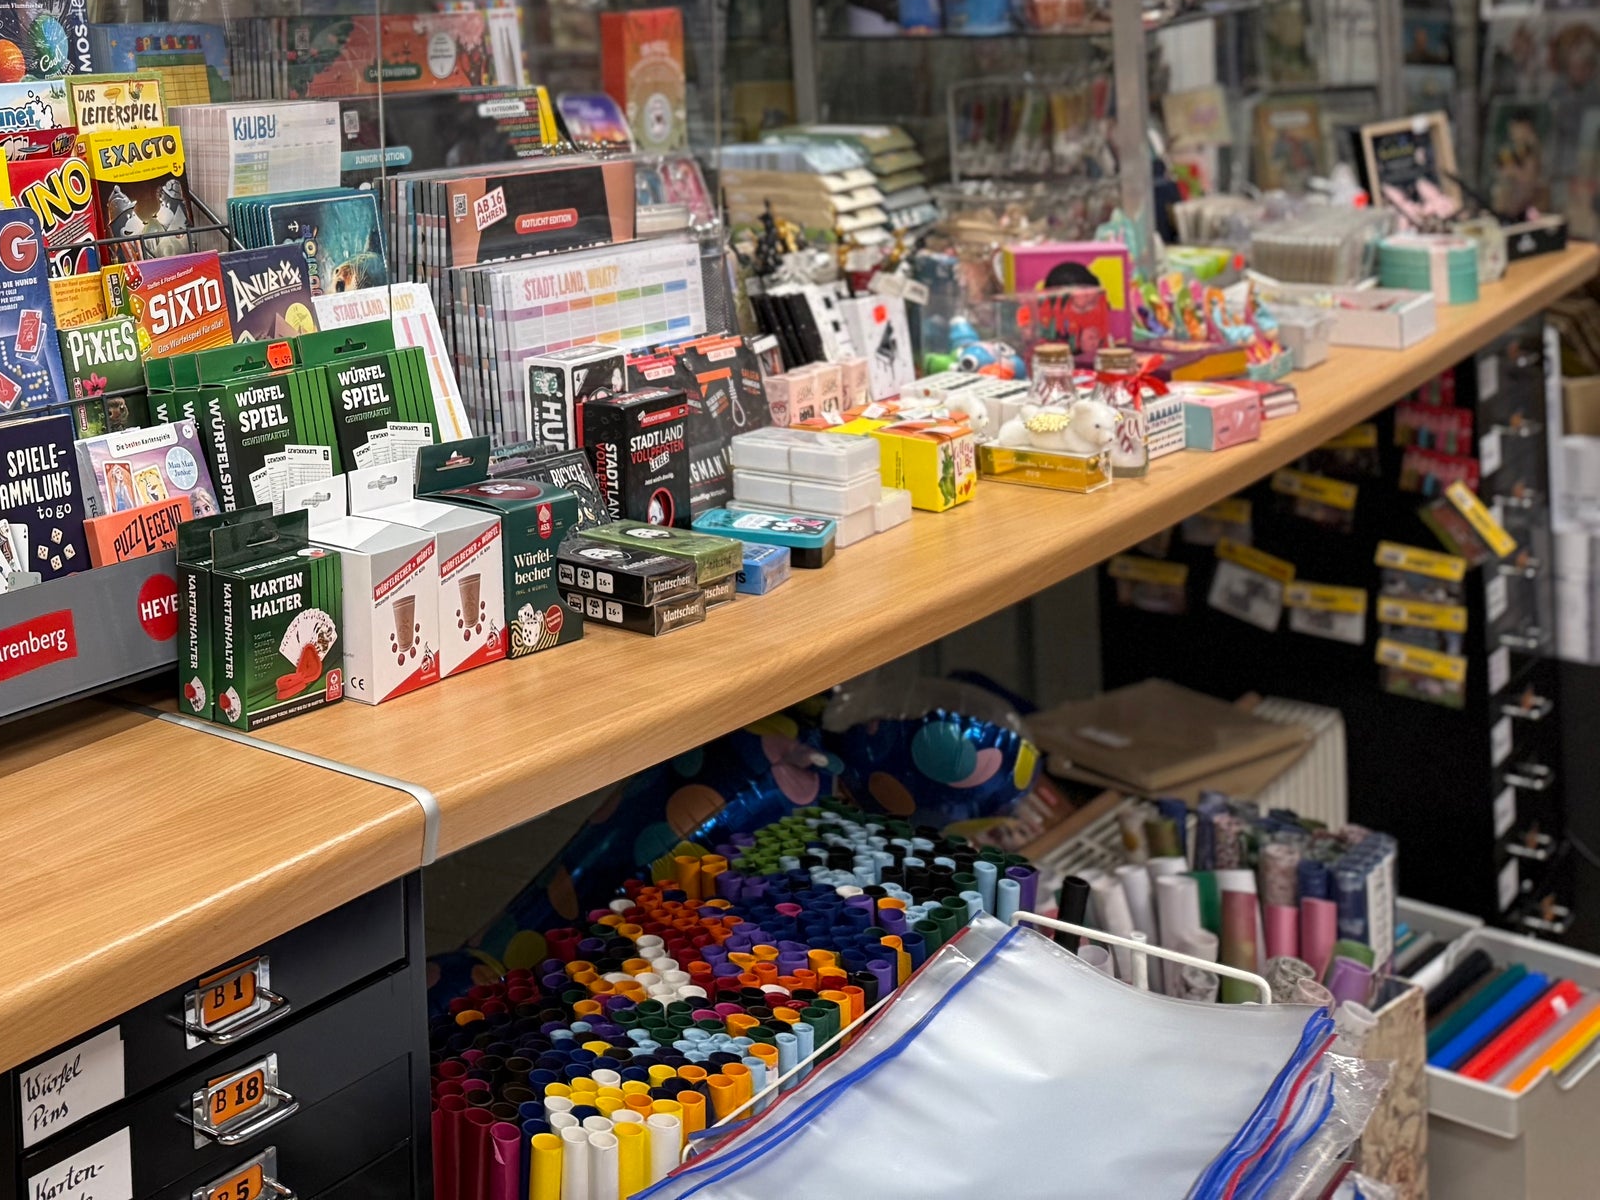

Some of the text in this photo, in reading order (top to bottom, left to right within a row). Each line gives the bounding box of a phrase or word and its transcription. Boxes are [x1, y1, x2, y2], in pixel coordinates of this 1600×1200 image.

[77, 88, 95, 104] DAS
[81, 104, 159, 127] LEITERSPIEL
[99, 134, 177, 169] EXACTO
[475, 190, 504, 216] AB 16
[477, 205, 505, 231] JAHREN
[4, 280, 14, 289] DIE
[15, 276, 37, 287] HUNDE
[524, 265, 620, 303] STADT, LAND, WHAT?
[235, 386, 284, 414] WÜRFEL
[238, 407, 288, 434] SPIEL
[7, 445, 67, 479] SPIELE-
[549, 464, 588, 493] BICYCLE
[37, 502, 72, 520] to go
[513, 549, 554, 568] Würfel-
[249, 571, 304, 599] KARTEN
[515, 566, 552, 583] becher
[652, 573, 692, 595] klattschen
[250, 592, 303, 621] HALTER
[221, 583, 235, 680] KARTENHALTER
[213, 979, 245, 1008] B 1
[23, 1053, 83, 1104] Würfel
[215, 1078, 260, 1114] B 18
[27, 1102, 69, 1133] Pins
[35, 1163, 105, 1200] Karten-
